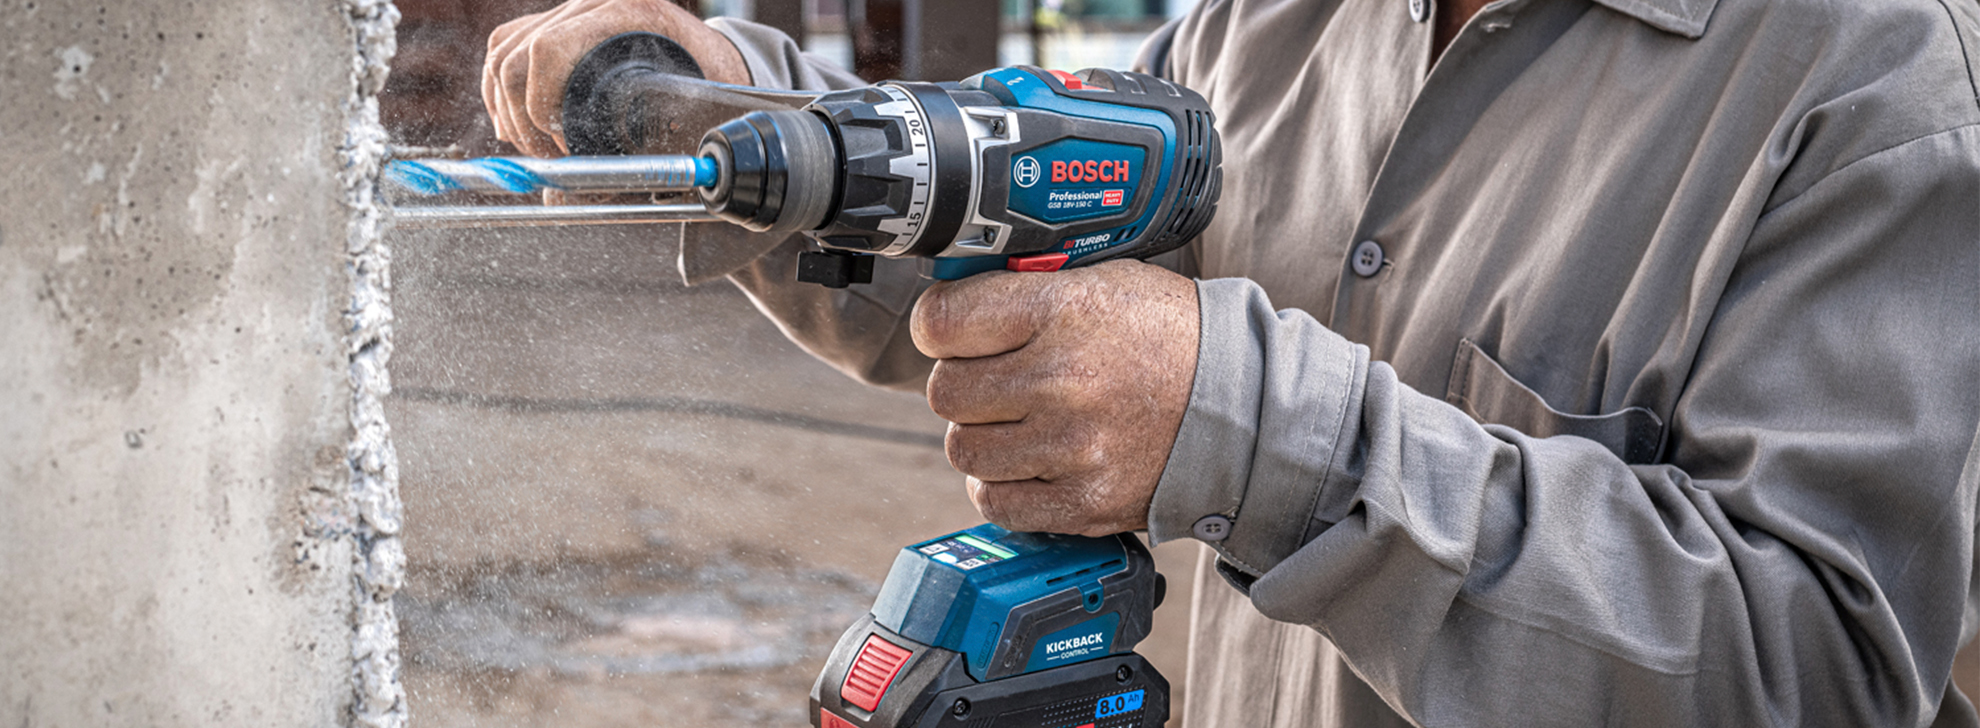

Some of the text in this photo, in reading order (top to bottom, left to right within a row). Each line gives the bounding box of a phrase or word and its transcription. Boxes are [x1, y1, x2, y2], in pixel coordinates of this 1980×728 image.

[908, 119, 924, 136] 20
[1051, 160, 1129, 182] BOSCH
[1049, 191, 1102, 201] Professional
[907, 212, 921, 227] 15
[1063, 233, 1111, 249] BITURBO
[1046, 632, 1103, 654] KICKBACK
[1060, 648, 1090, 660] CONTROL
[1100, 693, 1140, 715] 8.0 Ah
